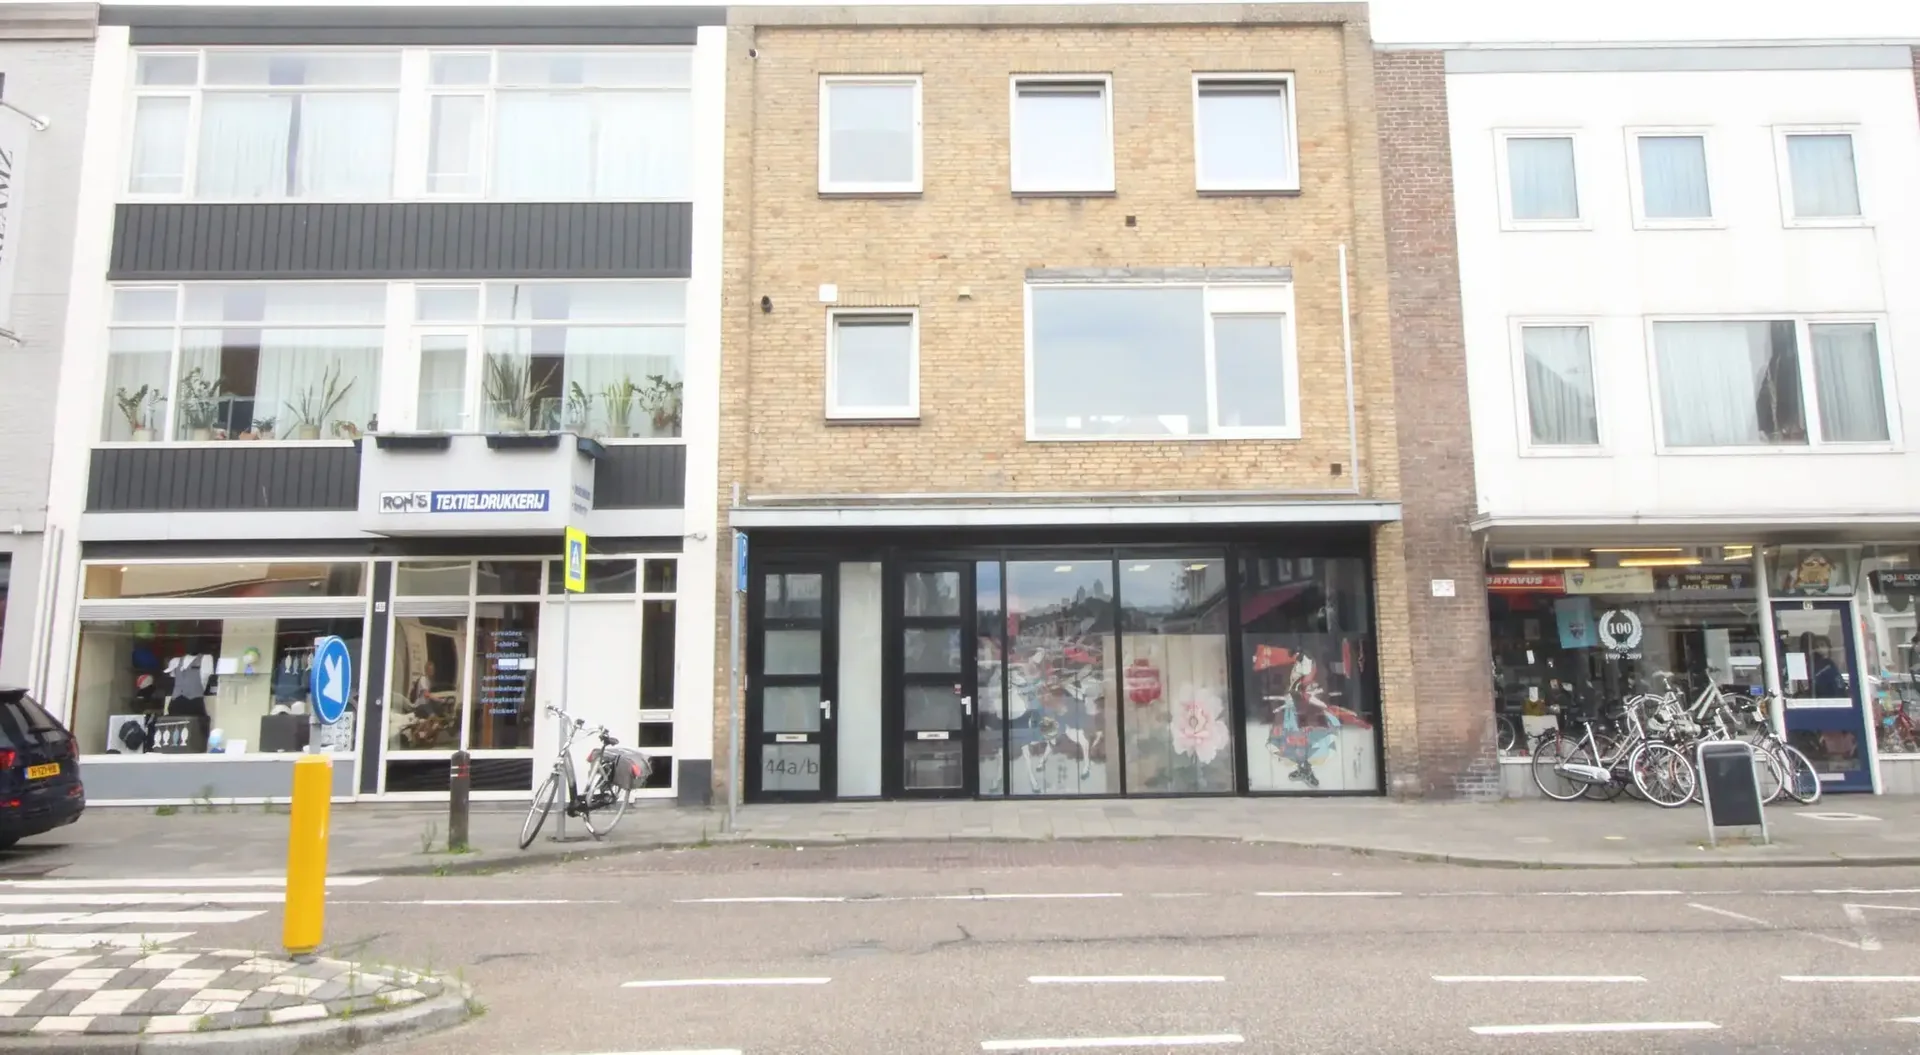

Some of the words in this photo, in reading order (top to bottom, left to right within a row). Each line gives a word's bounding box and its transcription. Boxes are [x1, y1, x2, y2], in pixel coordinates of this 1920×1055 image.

[436, 493, 545, 510] TEXTIELDRUKKERIJ
[1609, 622, 1632, 635] 100
[766, 758, 819, 776] 44a/b
